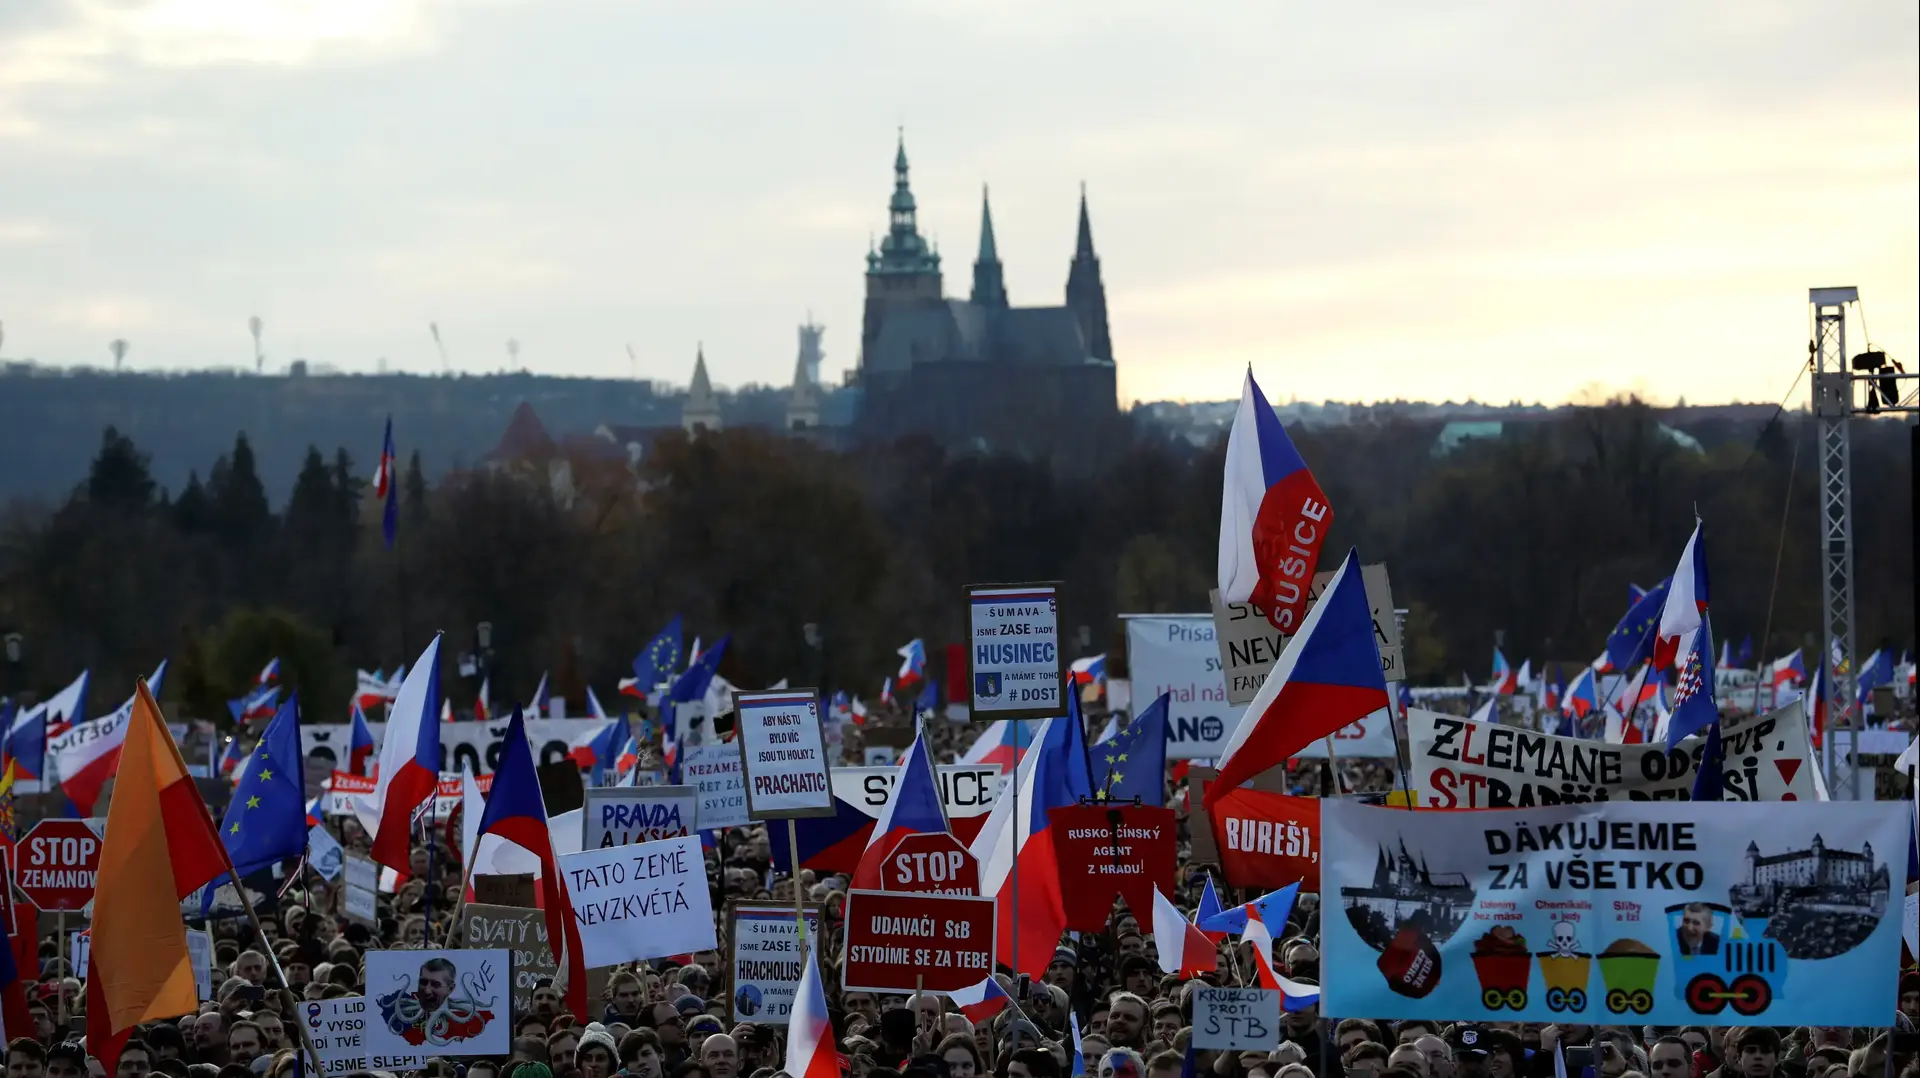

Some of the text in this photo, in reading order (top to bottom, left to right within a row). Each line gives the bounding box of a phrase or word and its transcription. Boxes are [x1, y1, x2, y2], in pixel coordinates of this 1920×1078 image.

[1274, 497, 1327, 628] SUŠICE
[977, 623, 1054, 636] JSME ZASE TADY
[977, 642, 1055, 665] HUSINEC
[1011, 671, 1035, 680] MÁME
[1039, 672, 1060, 680] TOHO
[1009, 687, 1057, 701] # DOST
[763, 712, 801, 727] ABY NÁS TU
[769, 729, 800, 744] BYLO VÍC
[759, 749, 815, 762] JSOU TU HOLKY Z
[1427, 718, 1622, 785] ZLEMANE
[755, 772, 826, 795] PRACHATIC
[864, 771, 994, 805] SICE
[602, 803, 681, 829] PRAVDA
[1225, 817, 1318, 863] BUREŠI,
[1484, 821, 1697, 855] DÄKUJEME
[30, 837, 95, 866] STOP
[1093, 846, 1132, 856] AGENT
[570, 862, 625, 892] TATO
[633, 844, 689, 880] ZEMĚ
[896, 850, 964, 883] STOP
[1087, 859, 1144, 874] Z HRADU!
[1488, 853, 1703, 890] ZA VŠETKO
[573, 882, 689, 925] NEVZKVÉTÁ
[469, 913, 534, 943] SVATÝ
[871, 914, 971, 939] UDAVAČI StB
[740, 943, 759, 951] JSME
[762, 940, 791, 951] ZASE
[850, 943, 989, 969] STYDÍME SE ZA TEBE
[471, 960, 495, 997] NE
[739, 960, 803, 981] HRACHOLUS
[771, 985, 793, 995] MÁME
[1208, 1004, 1251, 1015] PROTI
[327, 1019, 366, 1031] VYSO
[335, 1034, 361, 1048] TVÉ
